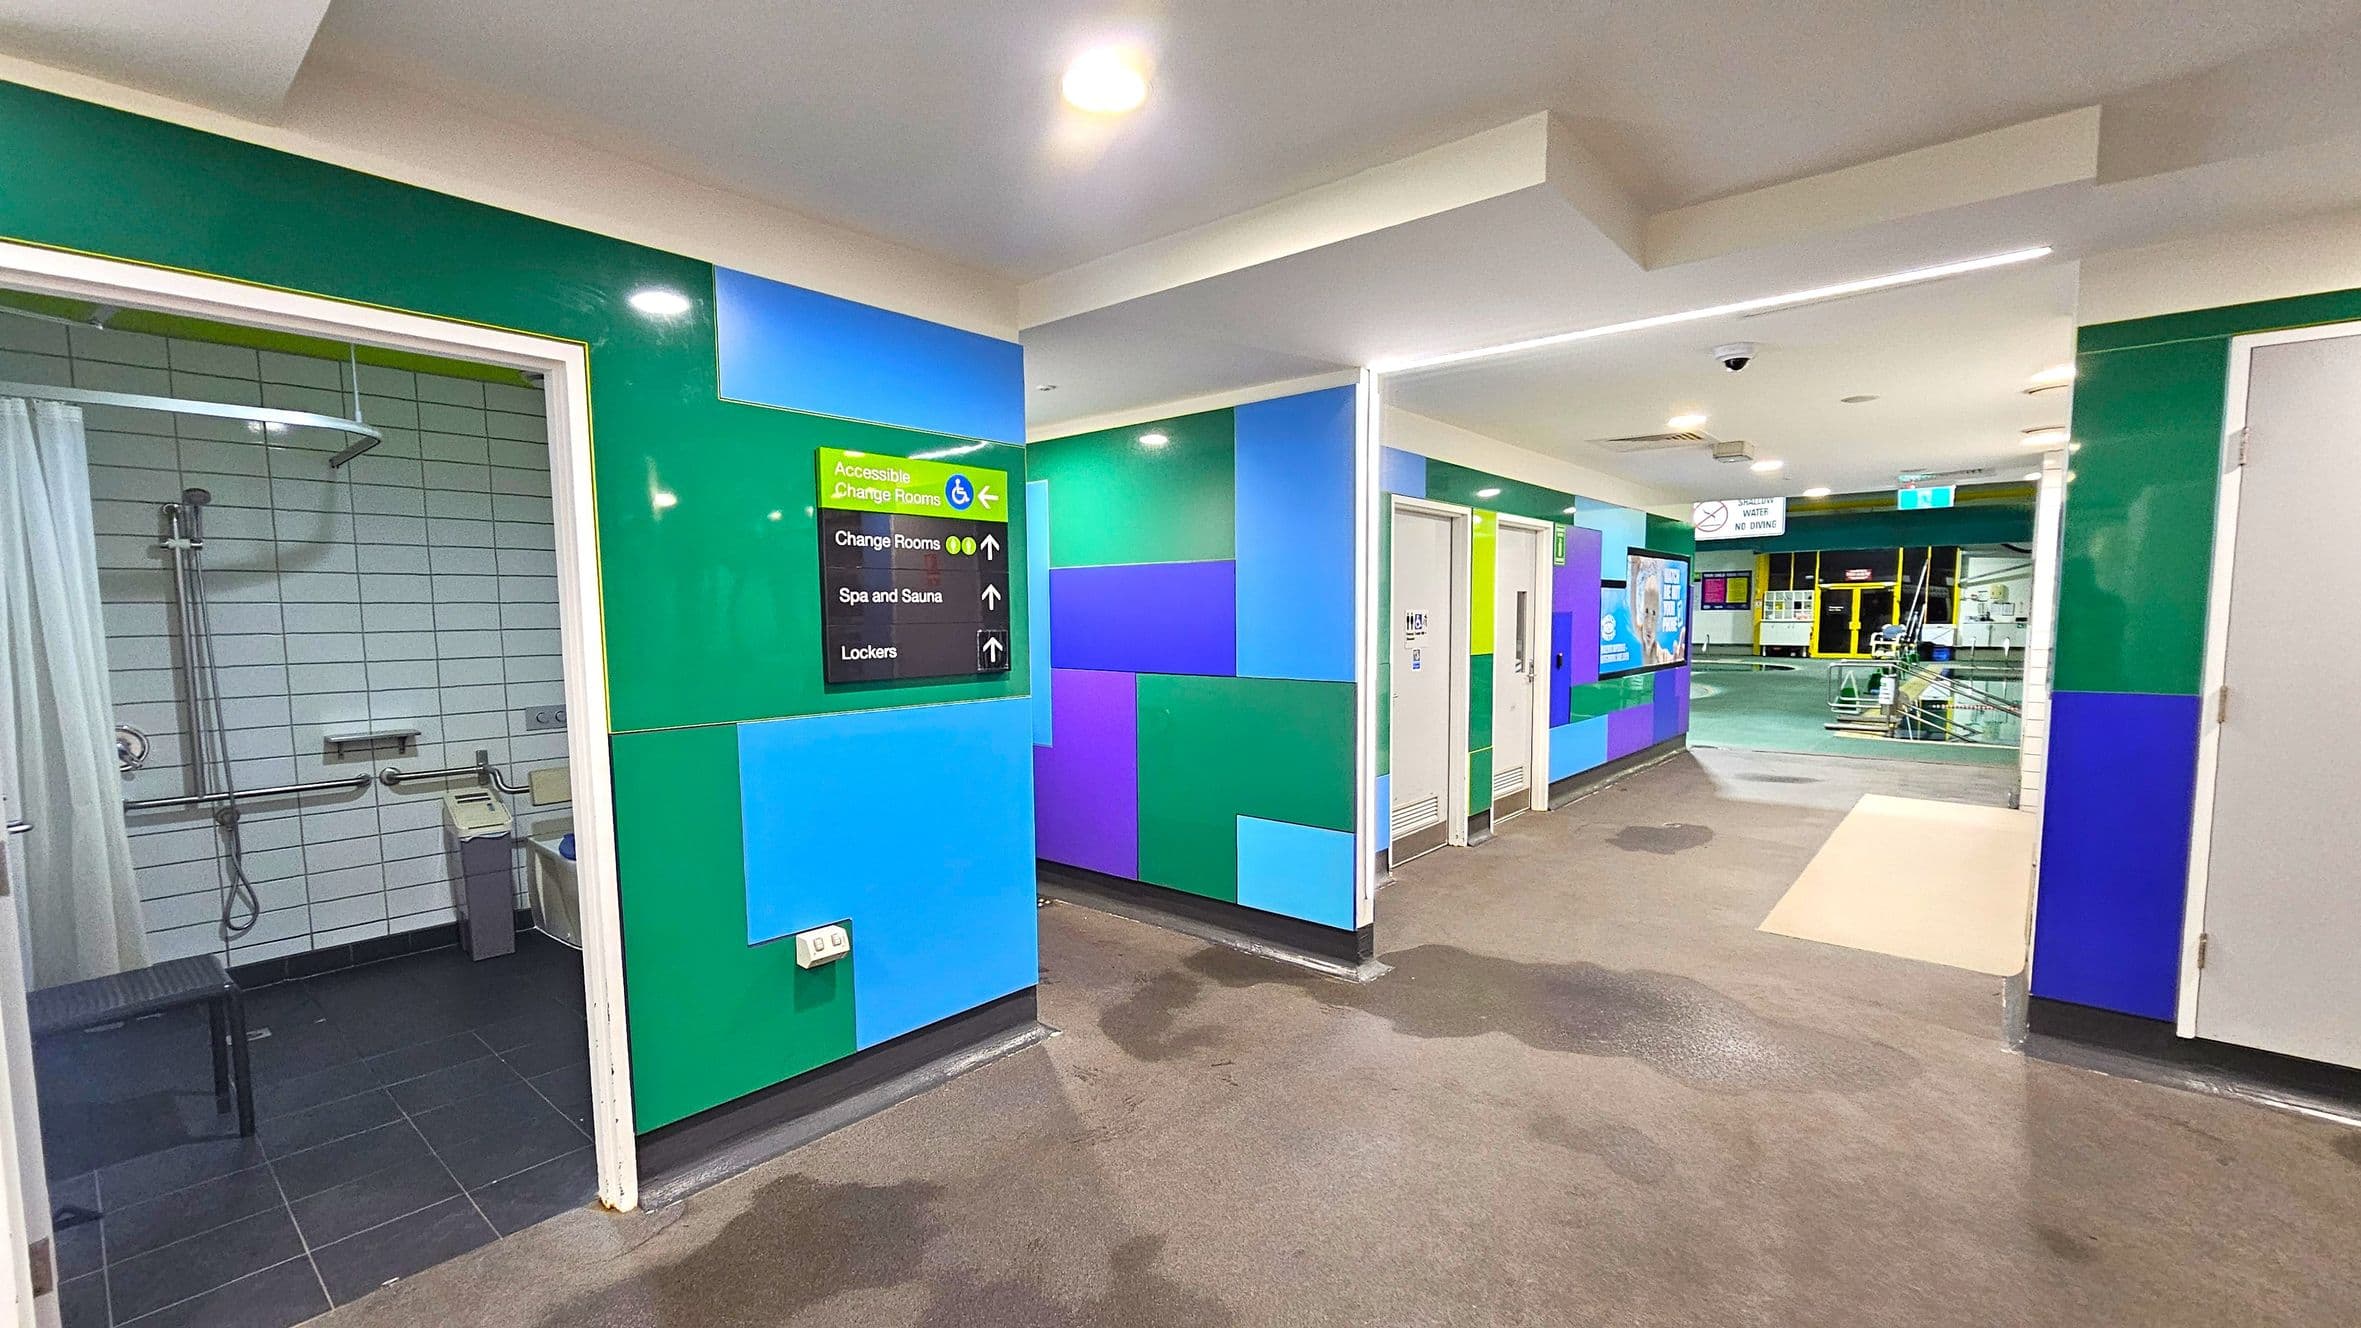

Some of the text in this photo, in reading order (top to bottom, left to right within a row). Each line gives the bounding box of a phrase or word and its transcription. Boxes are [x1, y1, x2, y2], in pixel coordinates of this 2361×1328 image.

[834, 460, 911, 484] Accessible
[835, 481, 941, 506] Change Rooms
[1743, 508, 1769, 517] WATER
[1735, 520, 1777, 531] NO DIVING
[835, 530, 941, 550] Change Rooms
[839, 587, 943, 606] Spa and Sauna
[841, 644, 897, 660] Lockers
